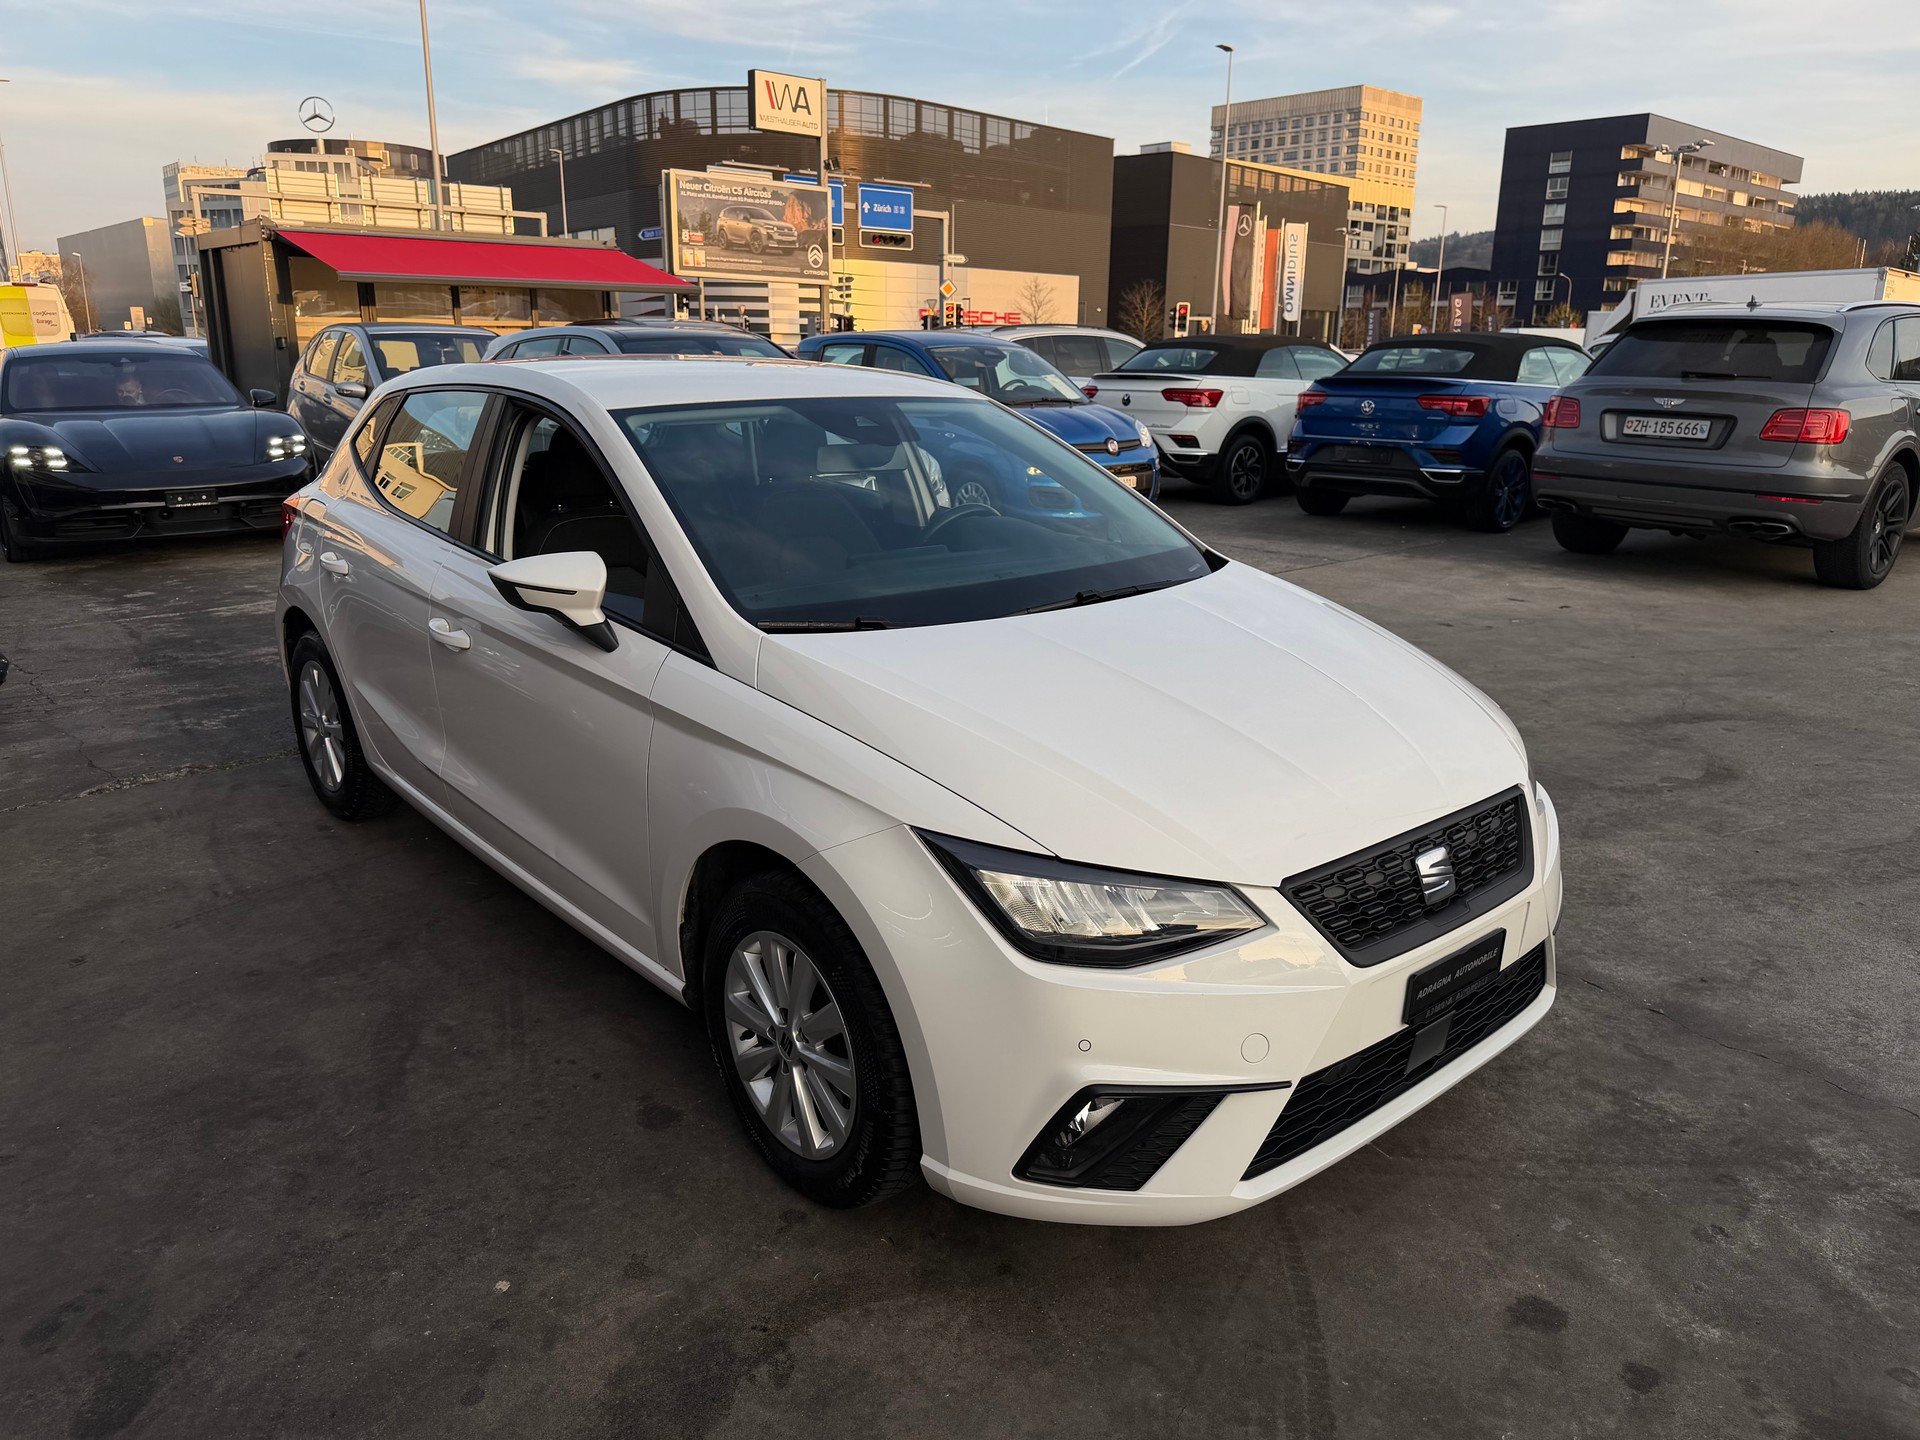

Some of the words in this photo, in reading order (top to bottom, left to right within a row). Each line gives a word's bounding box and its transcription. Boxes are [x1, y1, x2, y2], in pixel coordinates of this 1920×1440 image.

[802, 121, 819, 130] AUTO
[679, 180, 702, 190] Neuer
[703, 183, 730, 194] Citroën
[732, 186, 743, 196] C5
[744, 187, 772, 199] Aircross
[873, 203, 892, 214] Zürich
[919, 308, 1022, 325] PSCHE
[1416, 973, 1452, 1001] ADRAGNA
[1453, 947, 1499, 980] AUTOMOBILE
